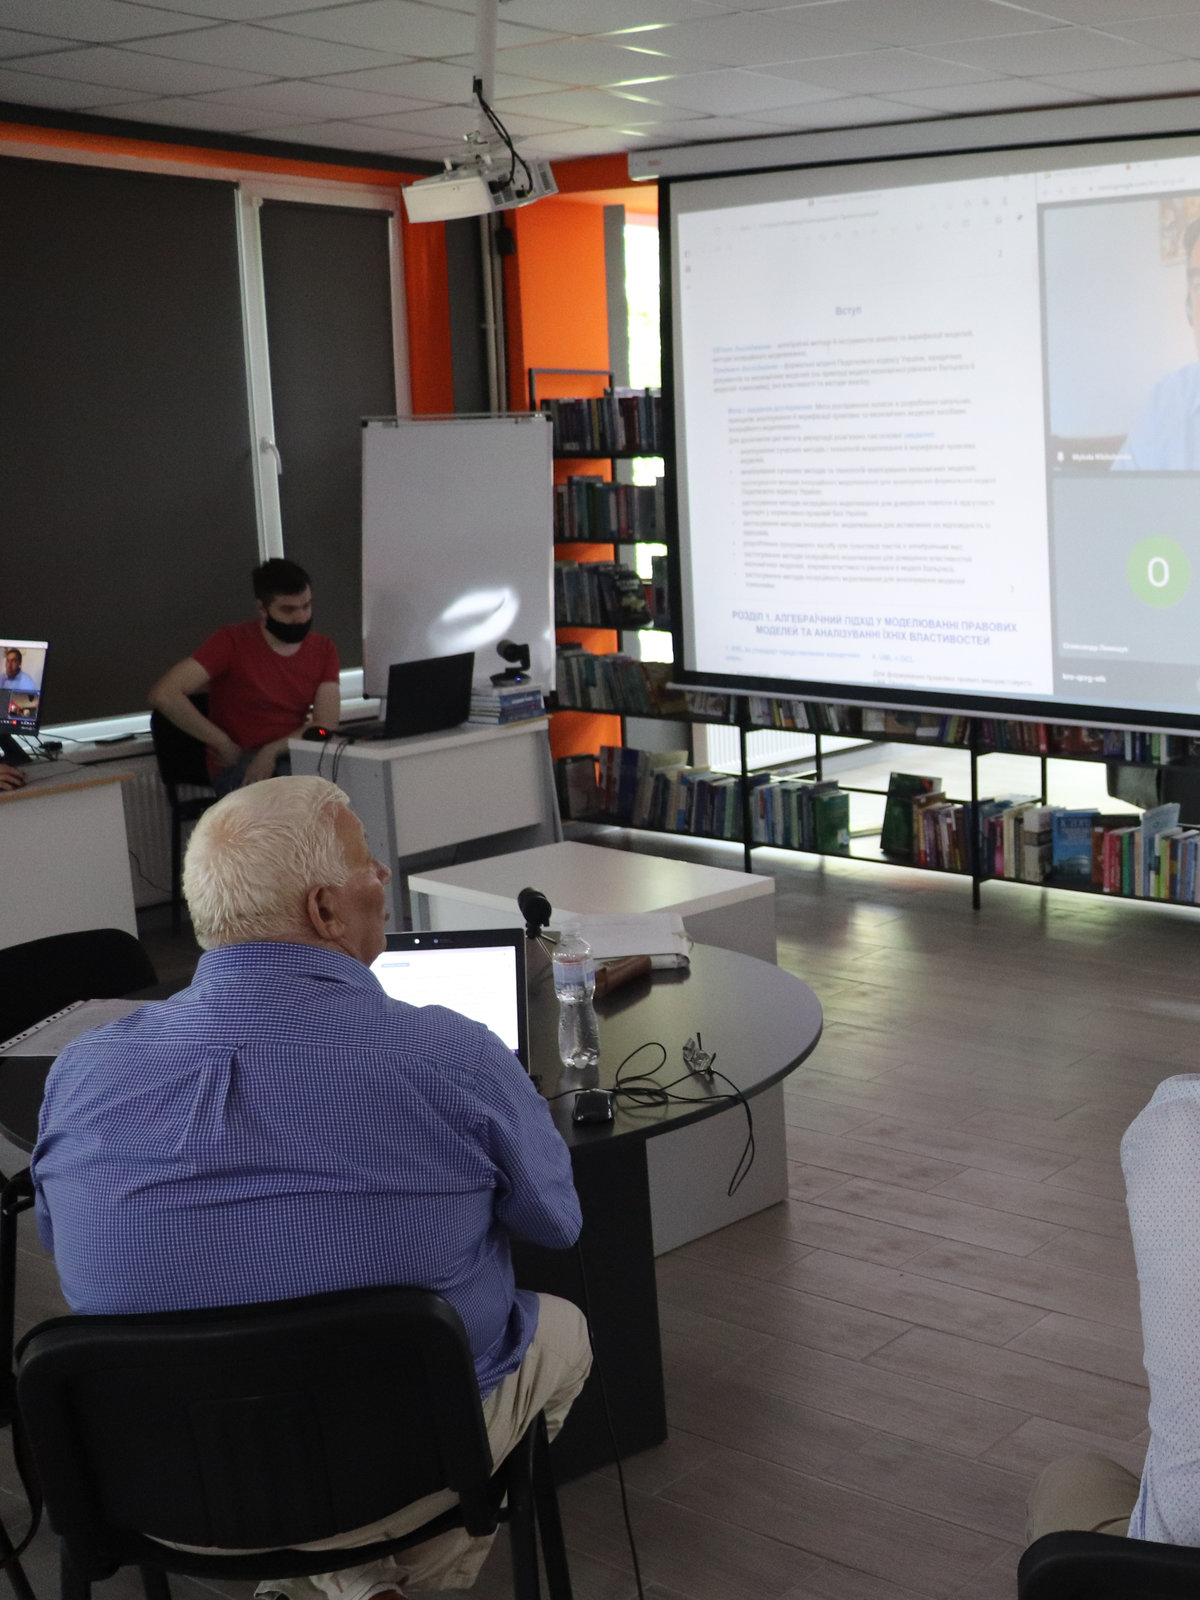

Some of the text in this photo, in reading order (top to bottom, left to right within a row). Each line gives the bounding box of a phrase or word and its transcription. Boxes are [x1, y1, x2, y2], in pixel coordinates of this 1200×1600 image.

[834, 305, 862, 318] Вступ
[732, 610, 764, 622] РОЗДІЛ
[775, 612, 842, 624] АЛГЕБРАЇЧНИЙ
[844, 615, 874, 626] ПІДХІД
[876, 616, 882, 626] У
[884, 616, 959, 630] МОДЕЛЮВАННІ
[961, 620, 1017, 632] ПРАВОВИХ
[755, 624, 990, 646] МОДЕЛЕЙ ТА АНАЛІЗУВАННІ ЇХНІХ ВЛАСТИВОСТЕЙ
